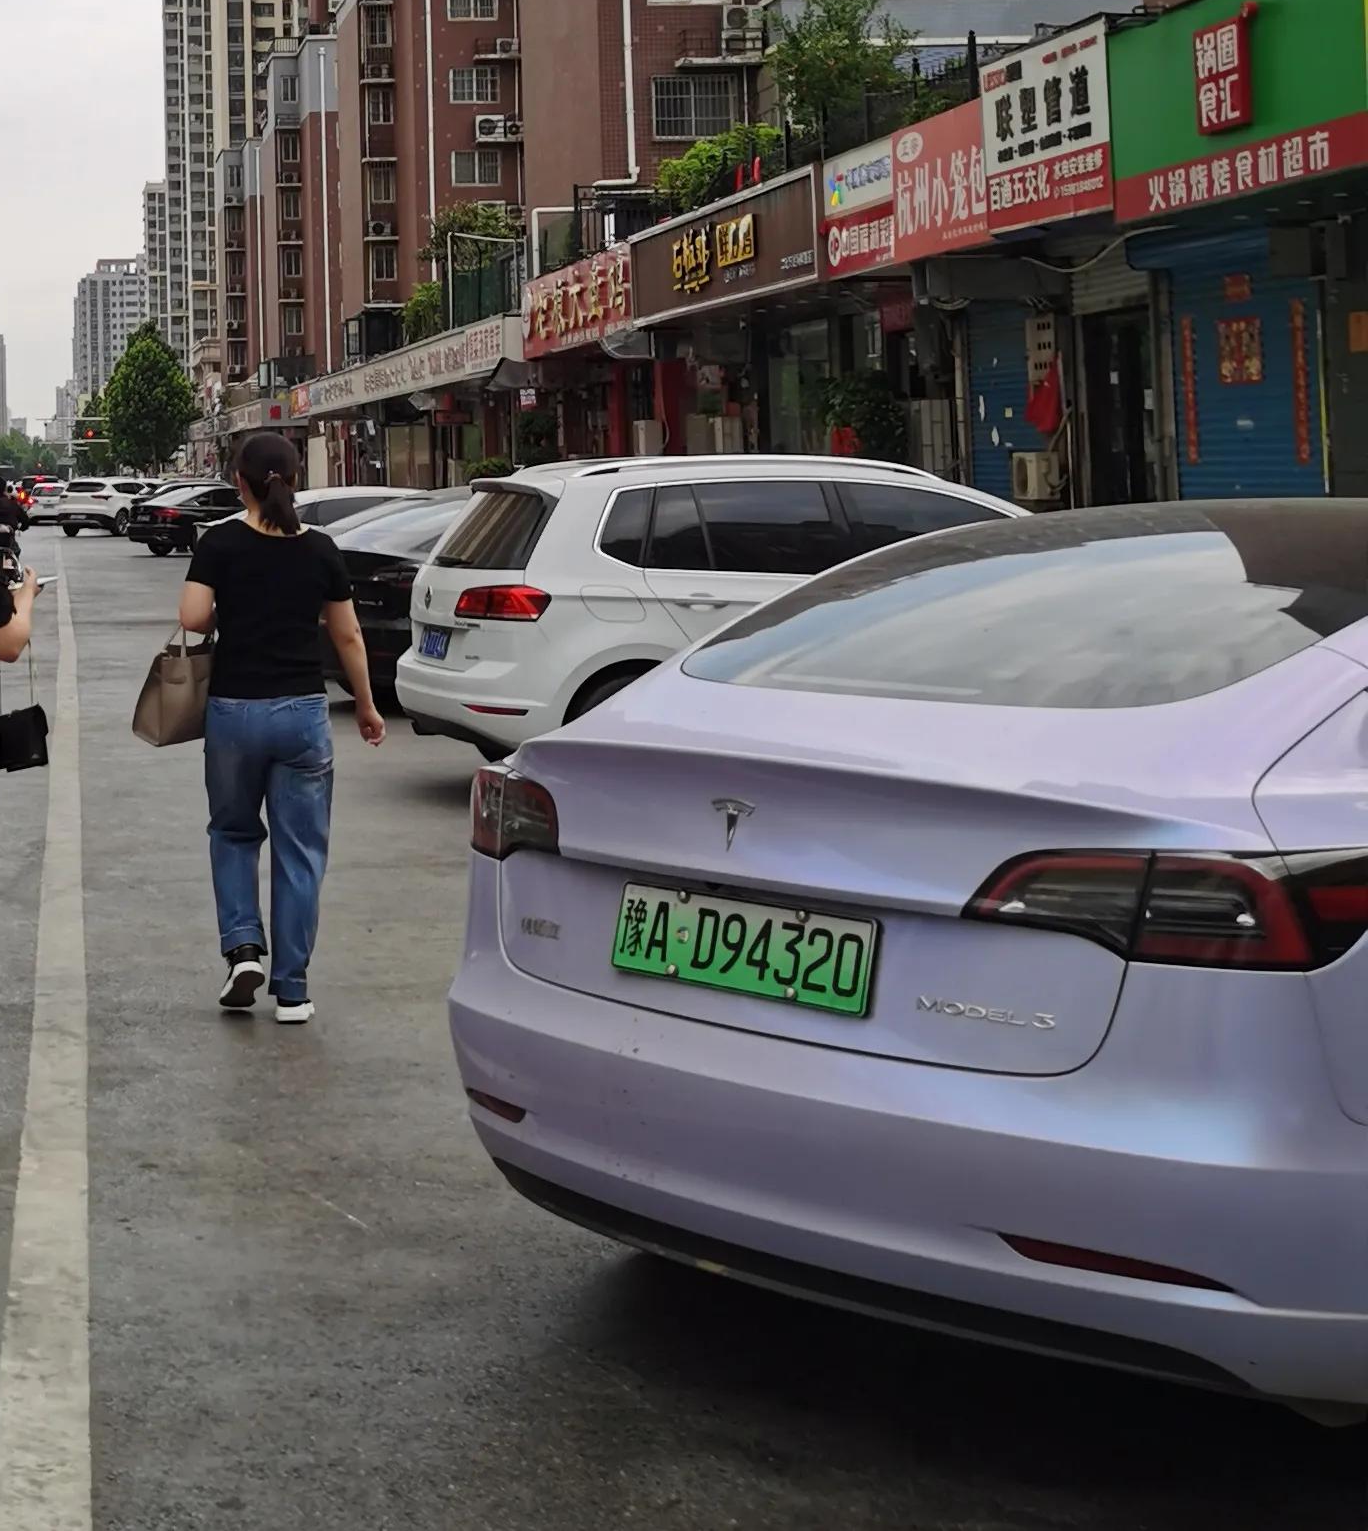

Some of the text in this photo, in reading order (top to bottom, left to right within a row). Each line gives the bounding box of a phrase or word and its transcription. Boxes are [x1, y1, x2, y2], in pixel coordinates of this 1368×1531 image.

[1195, 23, 1239, 79] 锅圈
[994, 64, 1091, 142] 联塑管道
[1199, 73, 1240, 127] 食汇
[896, 144, 988, 239] 杭州小笼包
[989, 163, 1050, 212] 百通五交化
[1148, 130, 1330, 212] 火锅烧烤食材超市
[916, 995, 1056, 1029] MODEL 3
